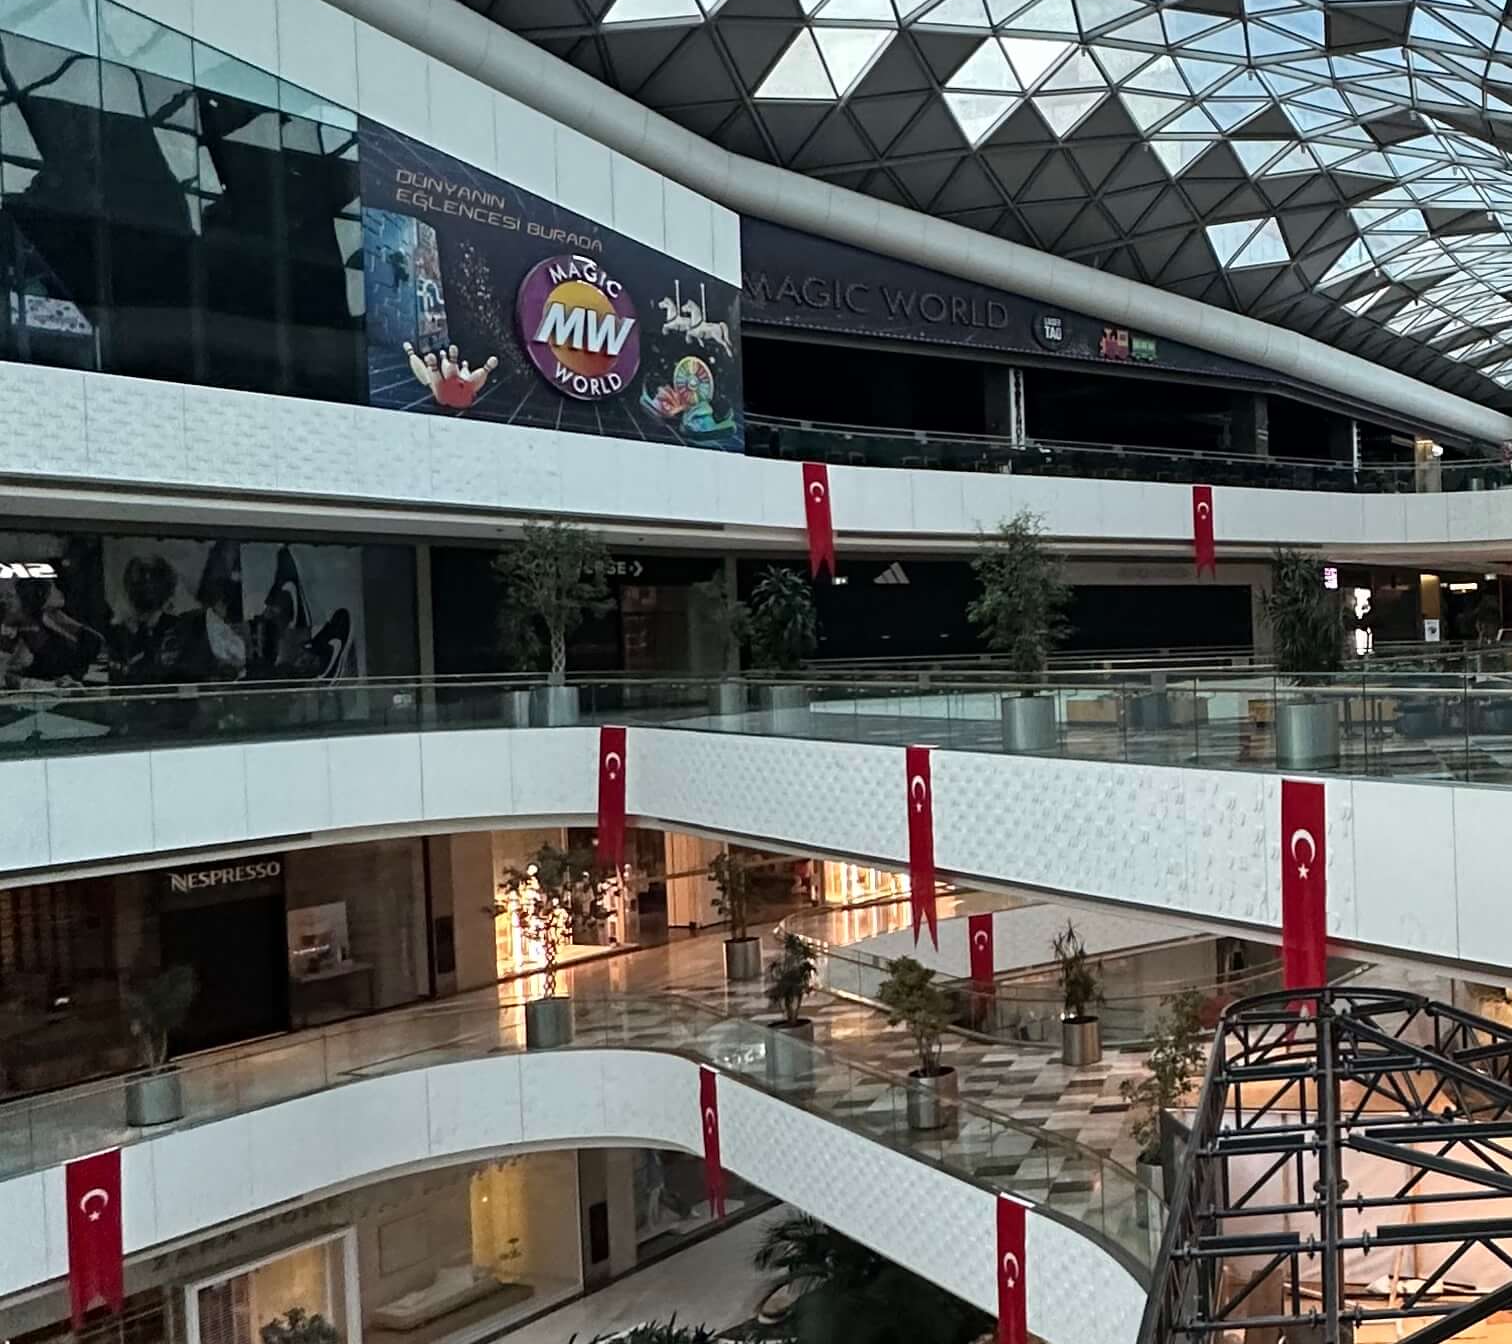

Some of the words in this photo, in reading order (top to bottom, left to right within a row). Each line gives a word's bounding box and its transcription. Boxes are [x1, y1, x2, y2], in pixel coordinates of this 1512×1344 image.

[395, 168, 505, 209] DÜNYANIN
[527, 222, 602, 252] BURADA
[549, 260, 623, 299] MAGIC
[741, 272, 869, 314] MAGIC
[881, 286, 1009, 329] WORLD
[534, 302, 636, 356] MW
[554, 365, 623, 396] WORLD
[168, 861, 280, 893] NESPRESSO
